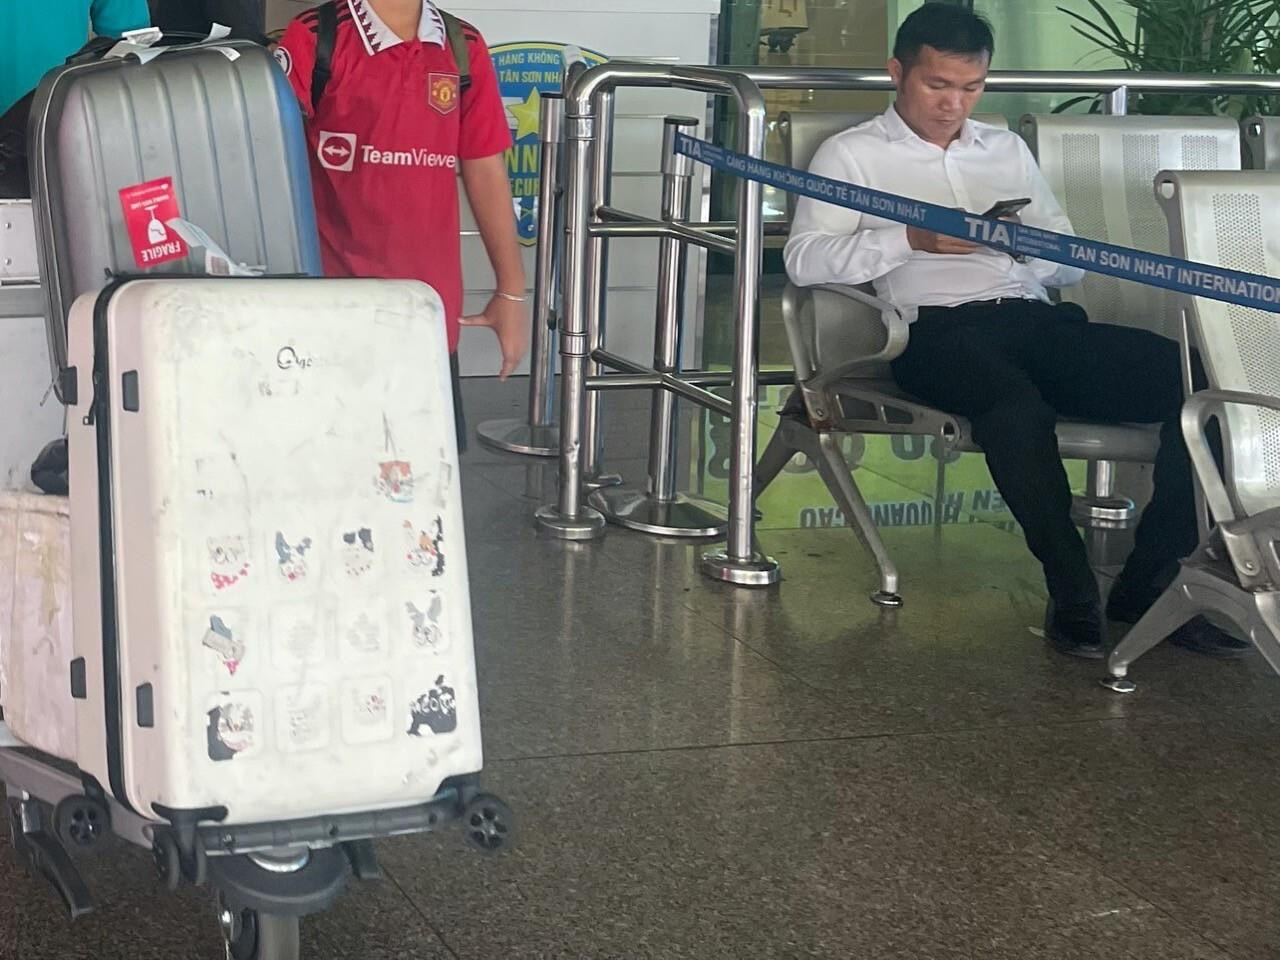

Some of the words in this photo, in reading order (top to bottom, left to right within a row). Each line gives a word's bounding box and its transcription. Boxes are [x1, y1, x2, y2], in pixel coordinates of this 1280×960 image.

[680, 136, 702, 159] TIA
[806, 178, 834, 197] QUỐC
[835, 182, 849, 201] TẾ
[964, 216, 1012, 247] TIA
[141, 241, 182, 263] FRAGILE
[1069, 243, 1097, 263] TAN
[1099, 250, 1130, 271] SON
[1133, 257, 1175, 281] NHAT
